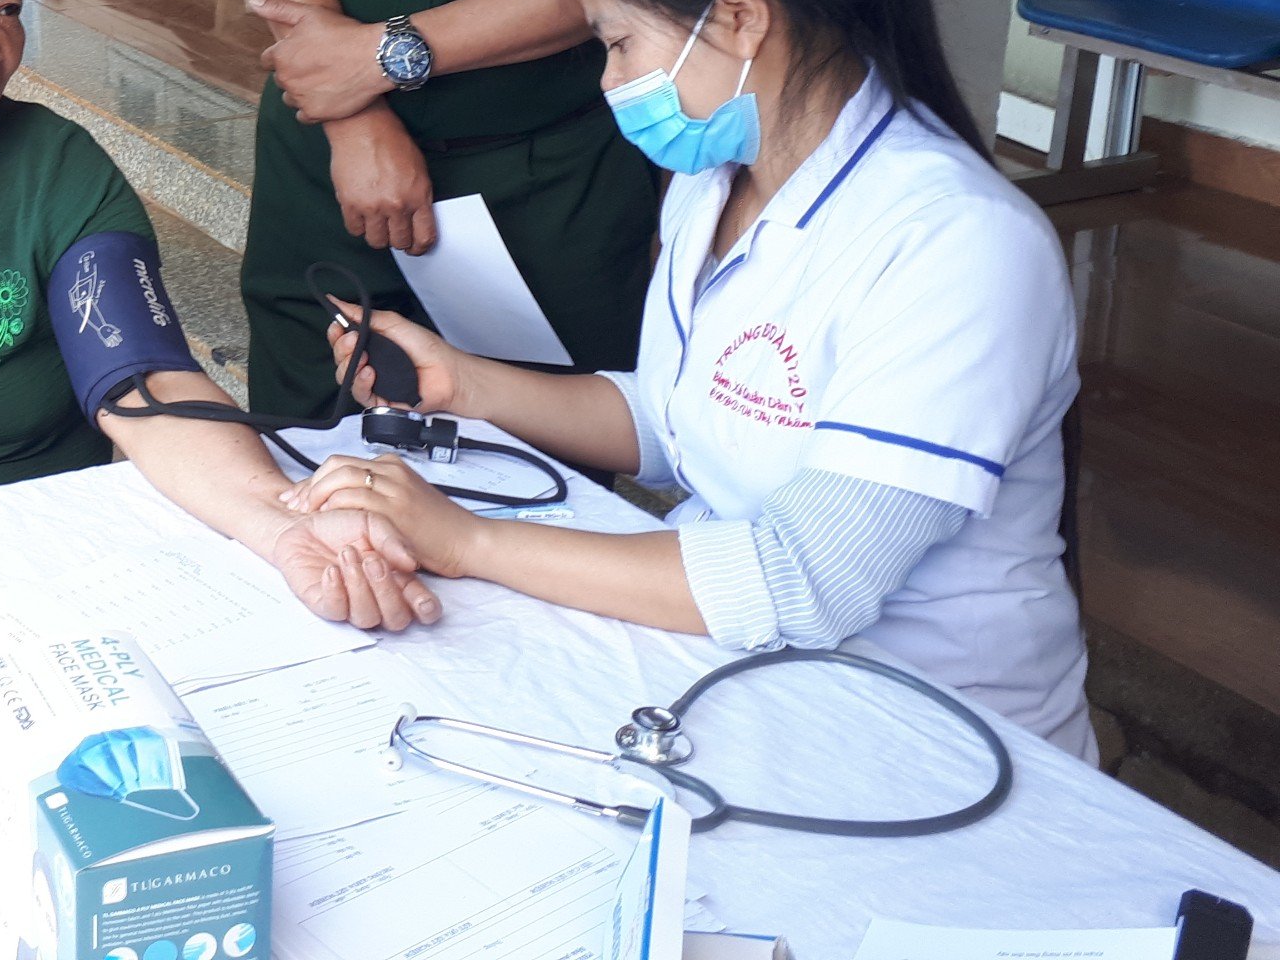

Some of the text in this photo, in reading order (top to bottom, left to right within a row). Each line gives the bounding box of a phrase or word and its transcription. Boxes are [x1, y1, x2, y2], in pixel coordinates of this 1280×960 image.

[133, 258, 171, 327] microlife
[49, 643, 106, 712] FACE MASK
[70, 638, 130, 707] MEDICAL
[100, 636, 145, 680] 4-PLY
